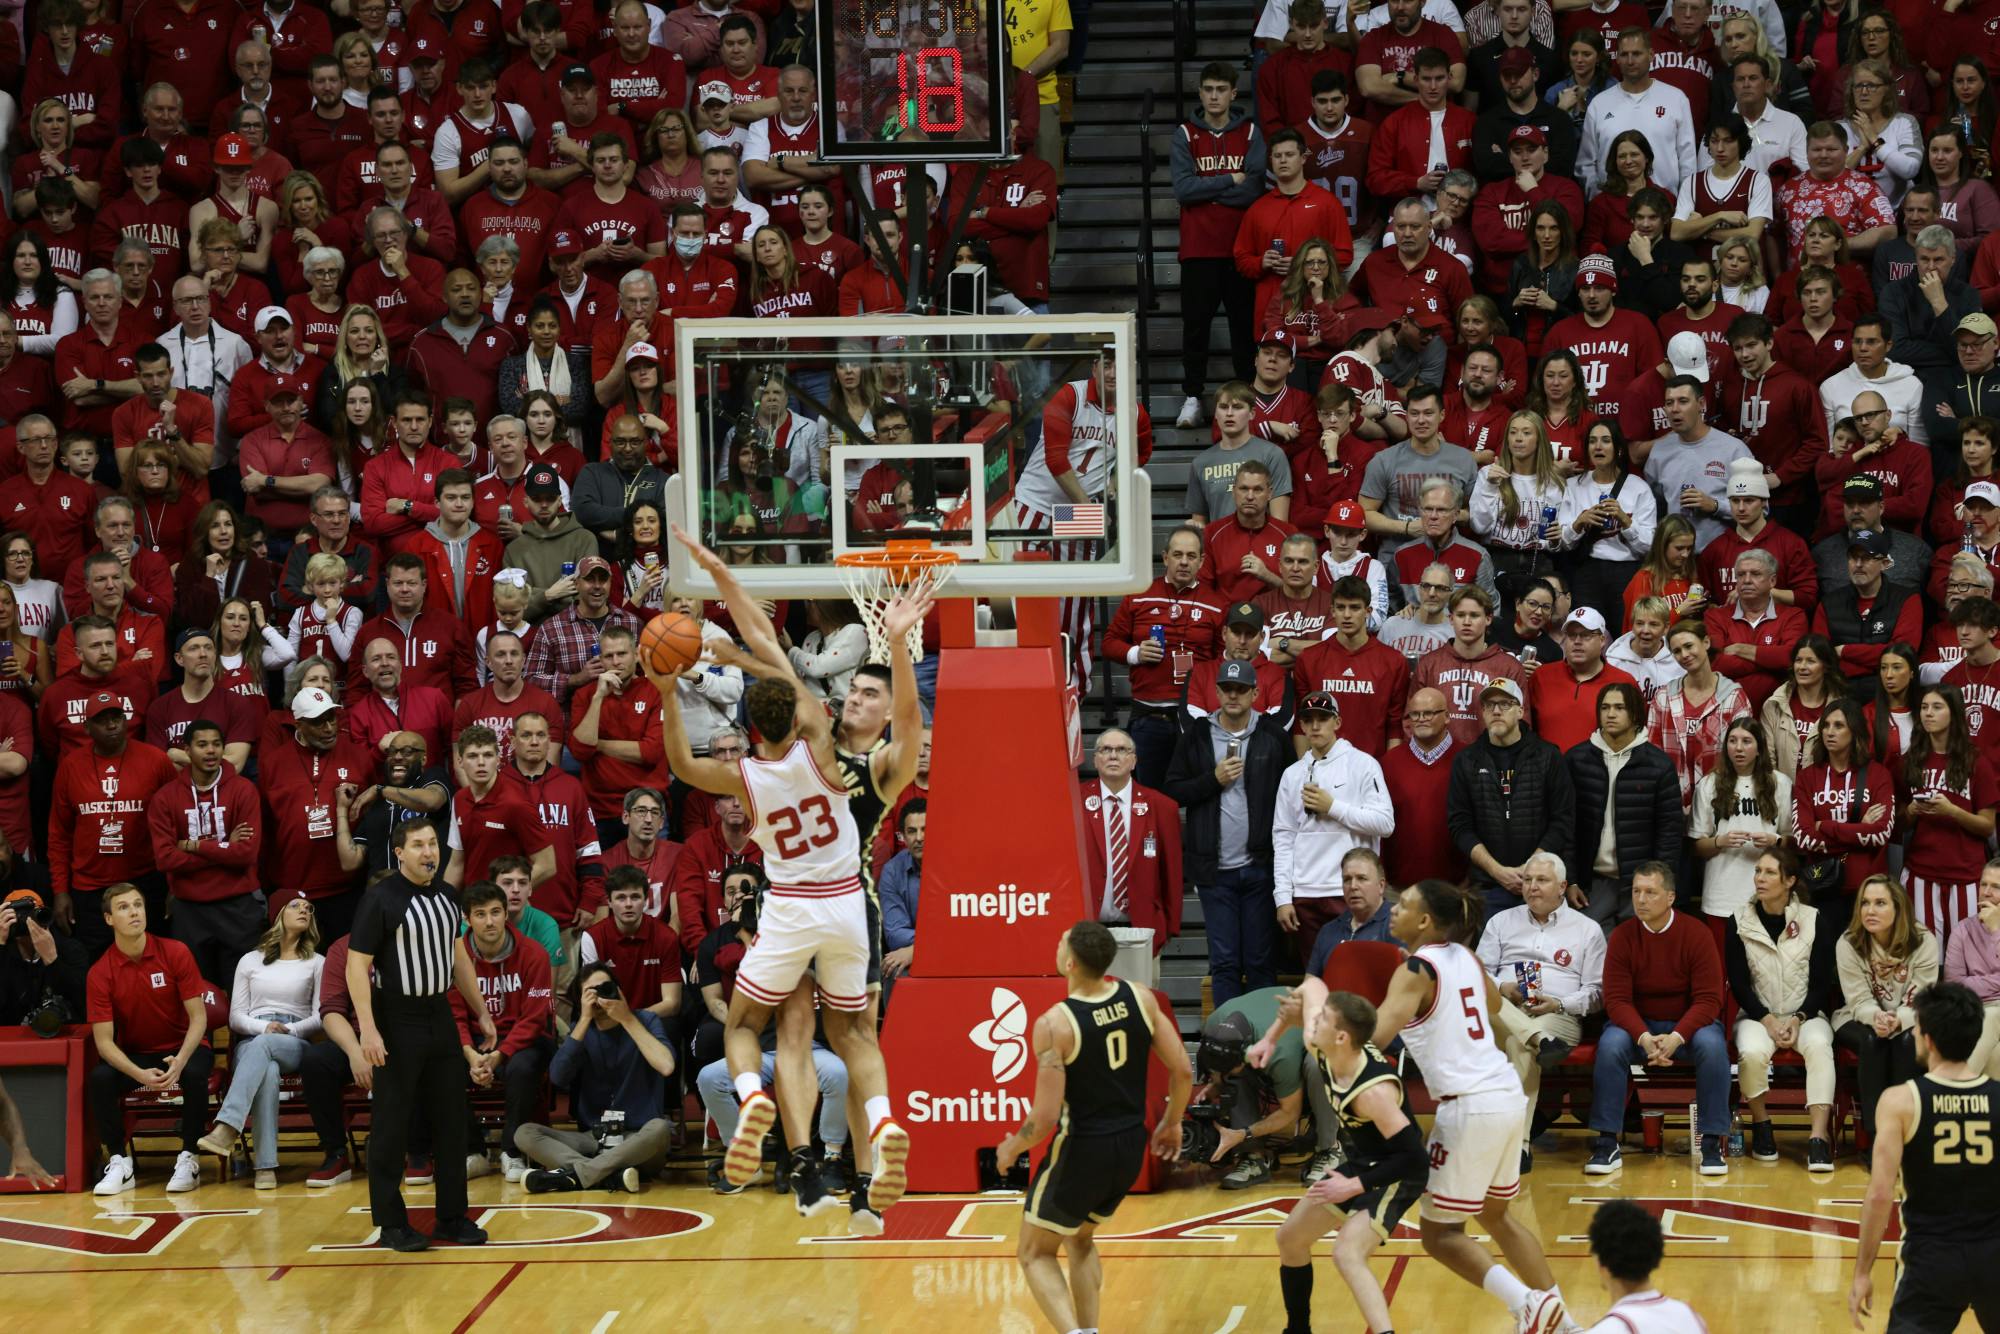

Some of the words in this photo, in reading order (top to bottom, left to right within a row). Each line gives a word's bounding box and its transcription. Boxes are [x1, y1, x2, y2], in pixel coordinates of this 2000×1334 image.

[610, 77, 659, 88] INDIANA
[610, 87, 660, 98] COURAGE
[897, 47, 964, 133] 18
[227, 143, 239, 157] IU
[1006, 183, 1025, 207] IU
[584, 218, 637, 236] HOOSIER
[47, 247, 81, 275] DIANA
[1424, 268, 1438, 283] IU
[1332, 362, 1350, 382] IU
[60, 495, 71, 510] IU
[1339, 507, 1350, 520] IU
[1266, 544, 1276, 557] IU
[1270, 611, 1326, 632] Indiana
[422, 639, 438, 658] IU
[1322, 679, 1375, 695] INDIANA
[1439, 669, 1490, 686] INDIANA
[634, 701, 646, 714] IU
[1453, 685, 1474, 711] IU
[101, 777, 119, 798] IU
[78, 799, 144, 815] BASKETBALL
[766, 794, 839, 861] 23
[950, 884, 1050, 924] meijer
[1092, 1002, 1129, 1027] GILLIS
[1459, 987, 1485, 1041] 5
[1106, 1028, 1128, 1071] 0
[907, 1088, 1033, 1122] Smith
[1931, 1093, 1990, 1114] MORTON
[1932, 1120, 1992, 1166] 25
[1430, 1141, 1449, 1171] IU
